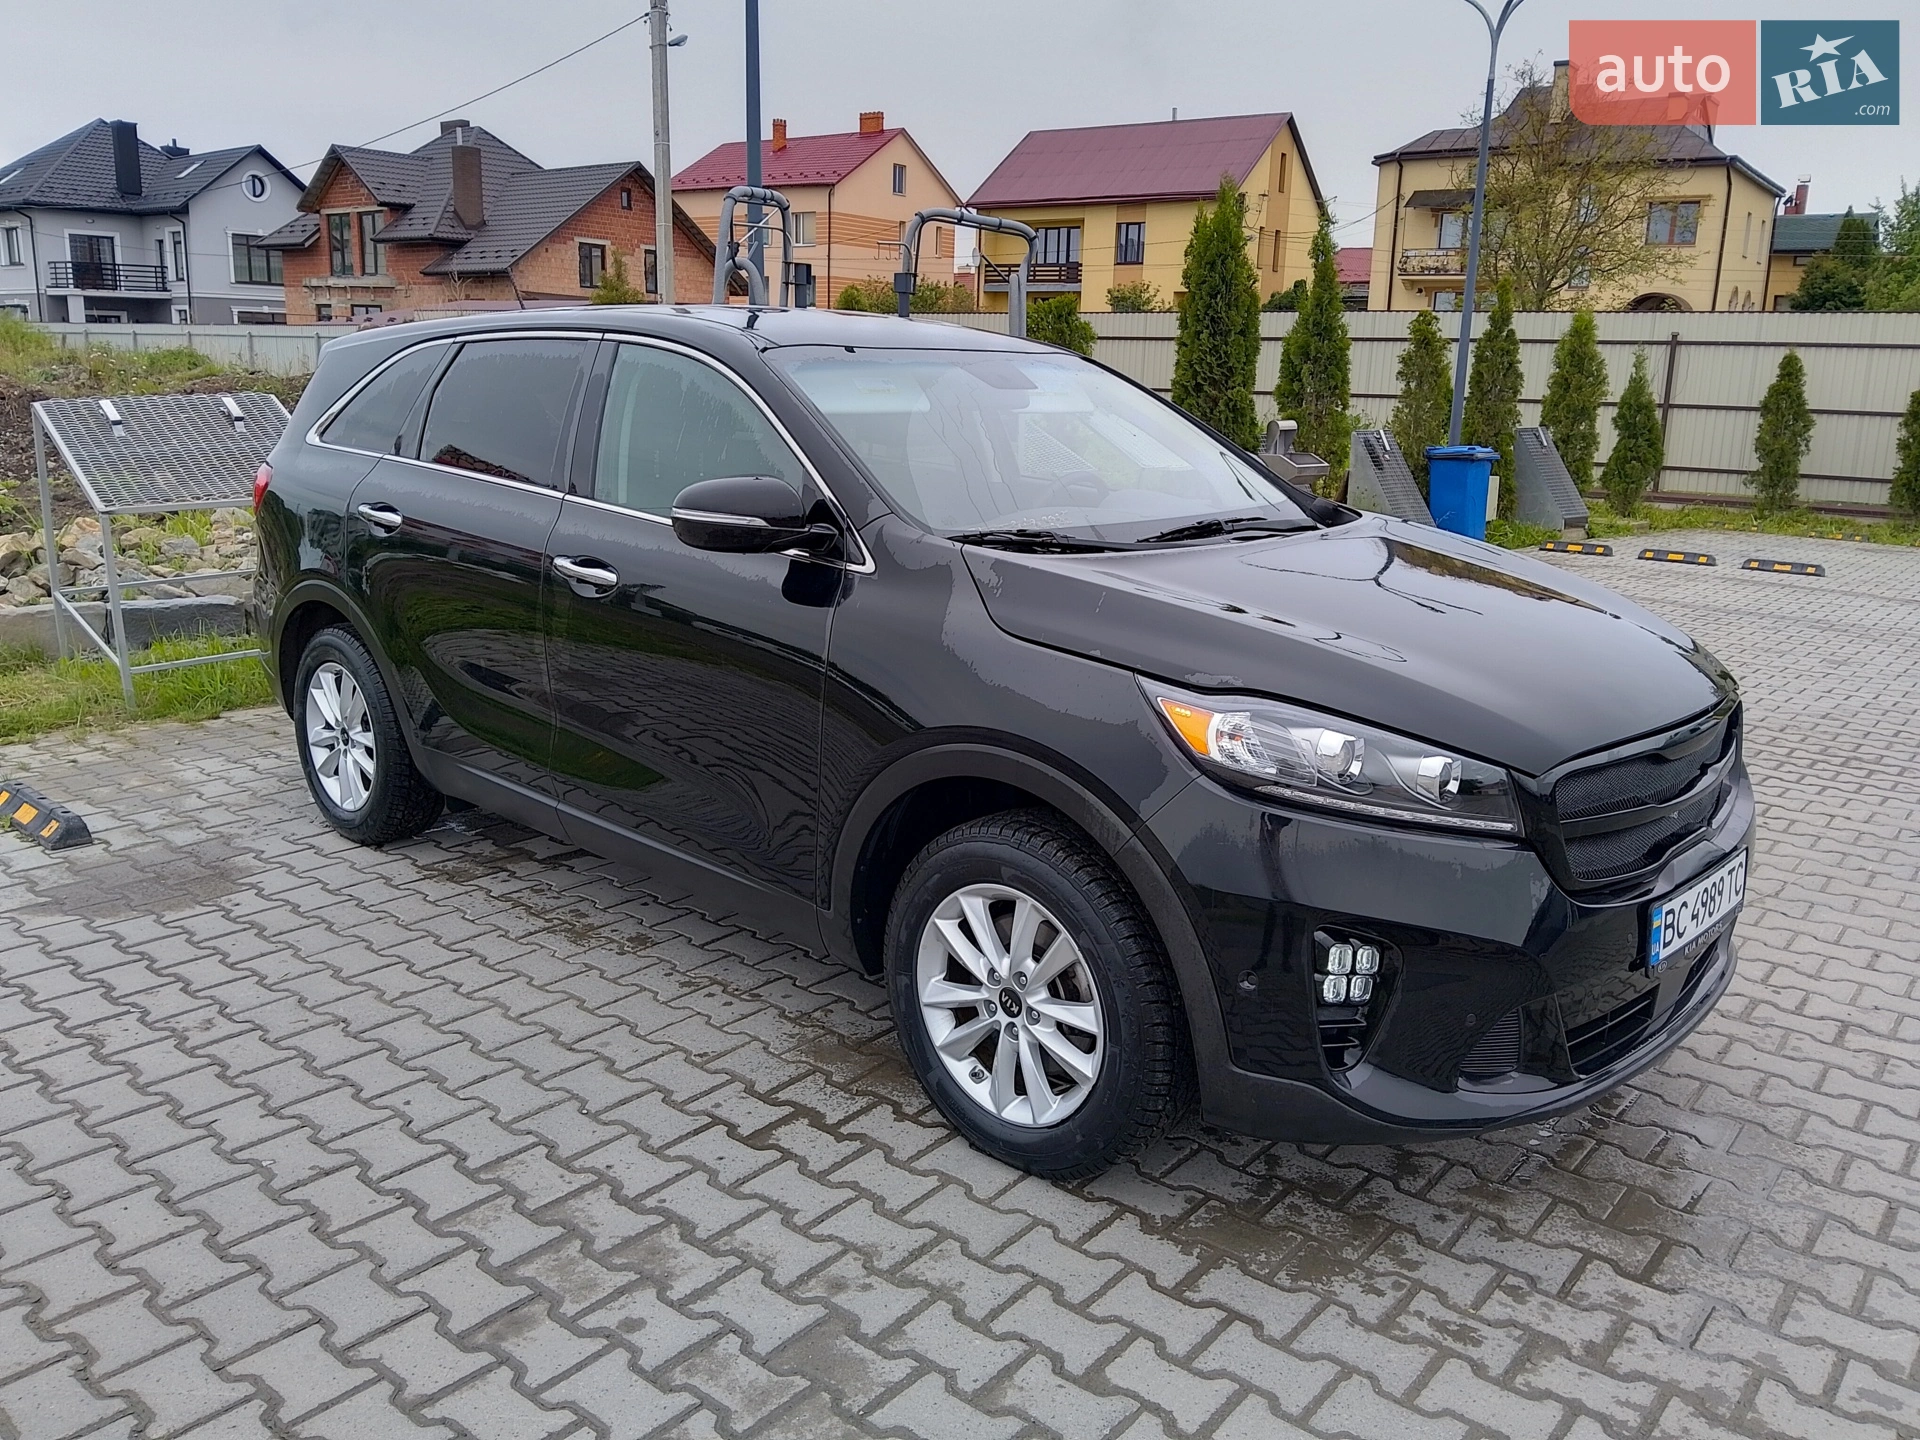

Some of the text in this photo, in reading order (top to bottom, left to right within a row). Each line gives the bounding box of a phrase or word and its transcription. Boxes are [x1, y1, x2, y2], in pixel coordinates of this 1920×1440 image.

[1662, 861, 1744, 950] BC 4989 TC
[1651, 941, 1660, 956] UA
[1684, 920, 1723, 956] KIA MOTORS
[1001, 991, 1019, 1014] KIA
